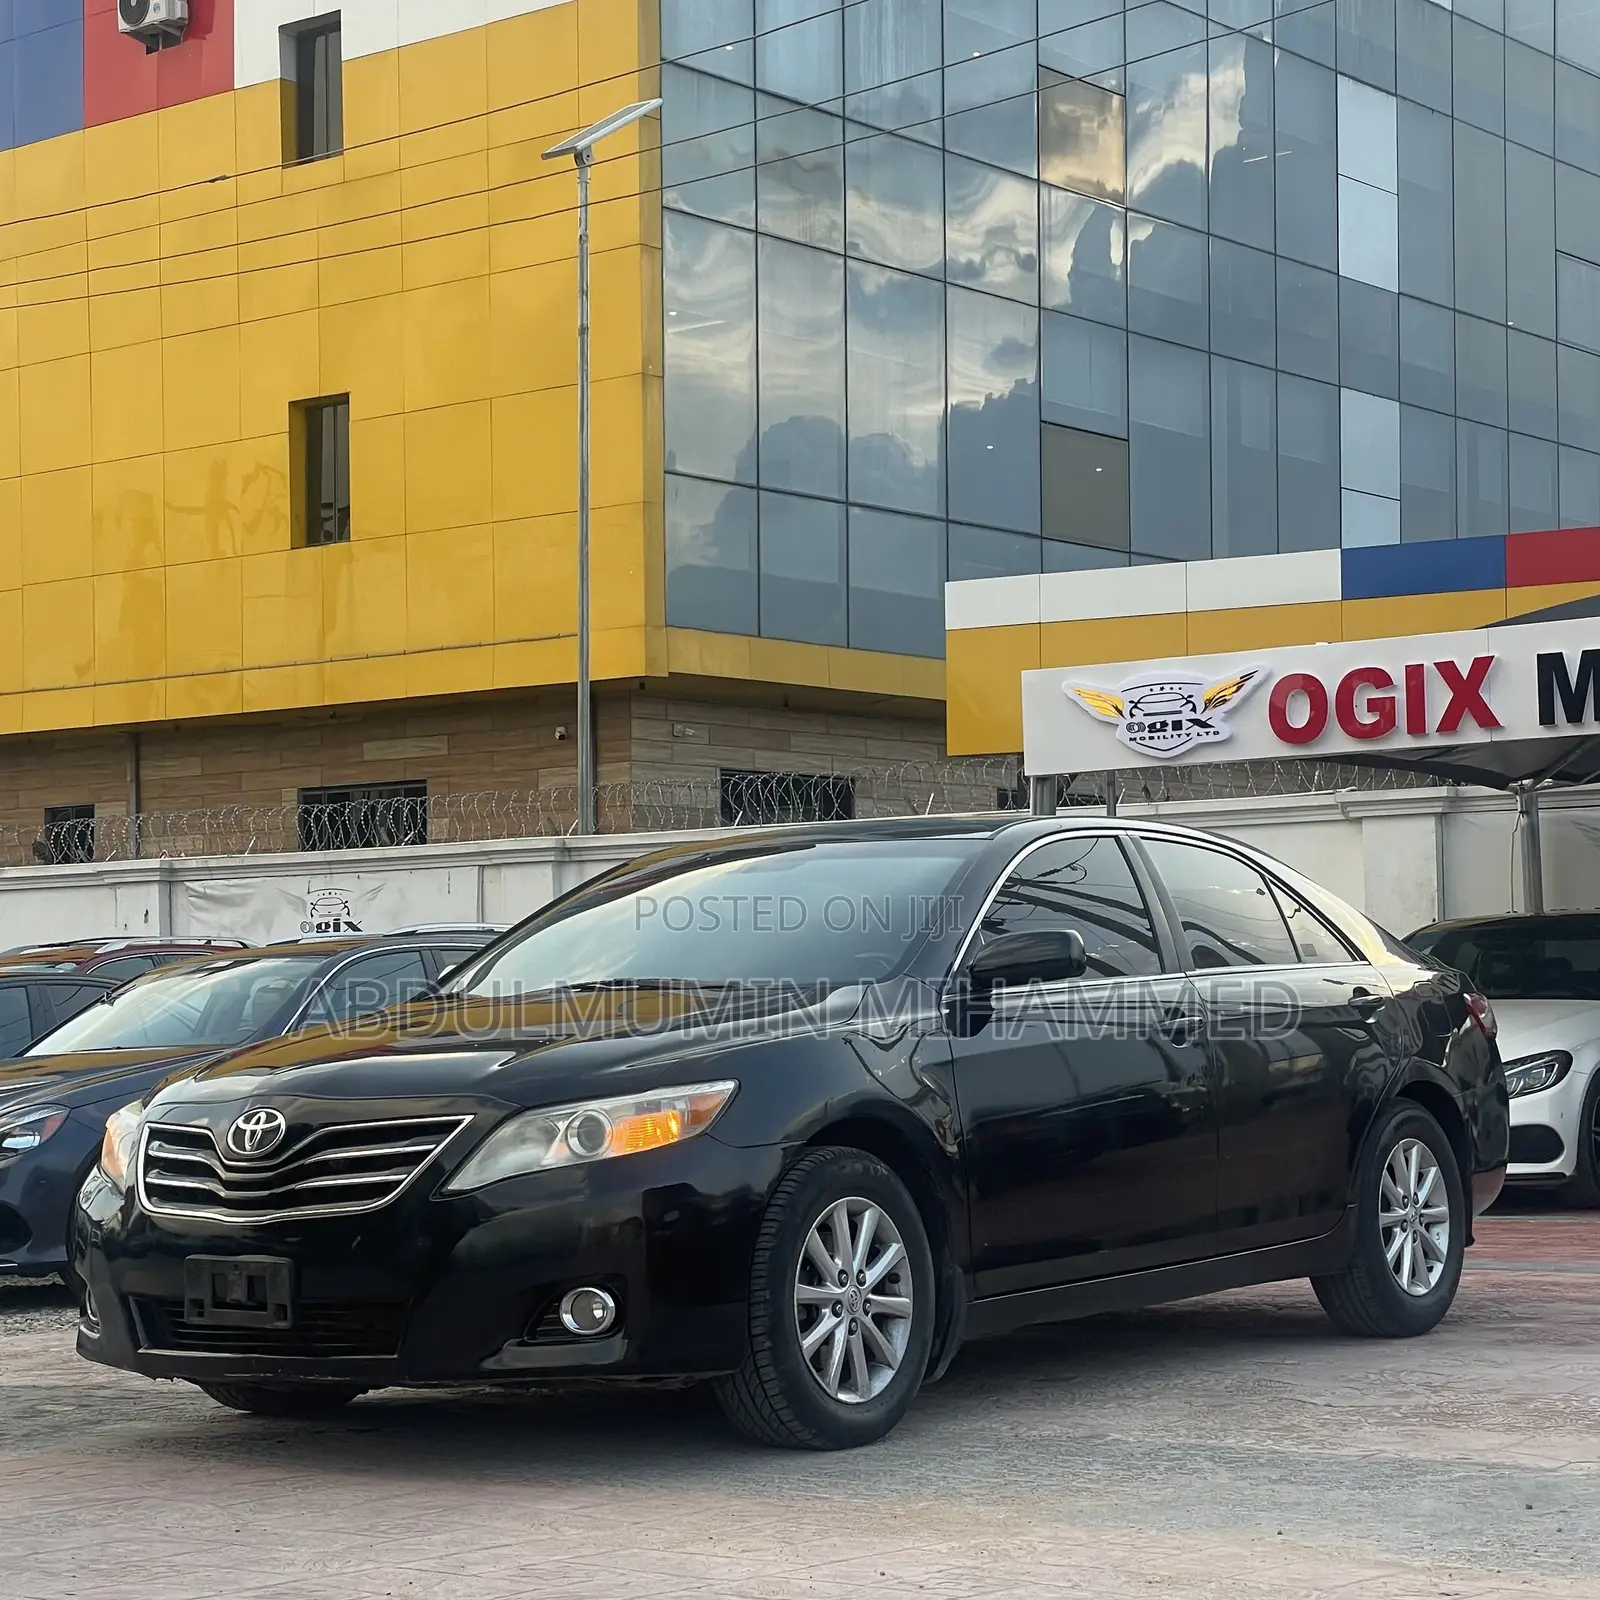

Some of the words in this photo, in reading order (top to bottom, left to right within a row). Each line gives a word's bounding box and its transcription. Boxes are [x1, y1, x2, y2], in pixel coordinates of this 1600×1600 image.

[1268, 655, 1502, 744] OGIX
[1537, 649, 1600, 727] M
[1128, 732, 1192, 742] MOBILITY
